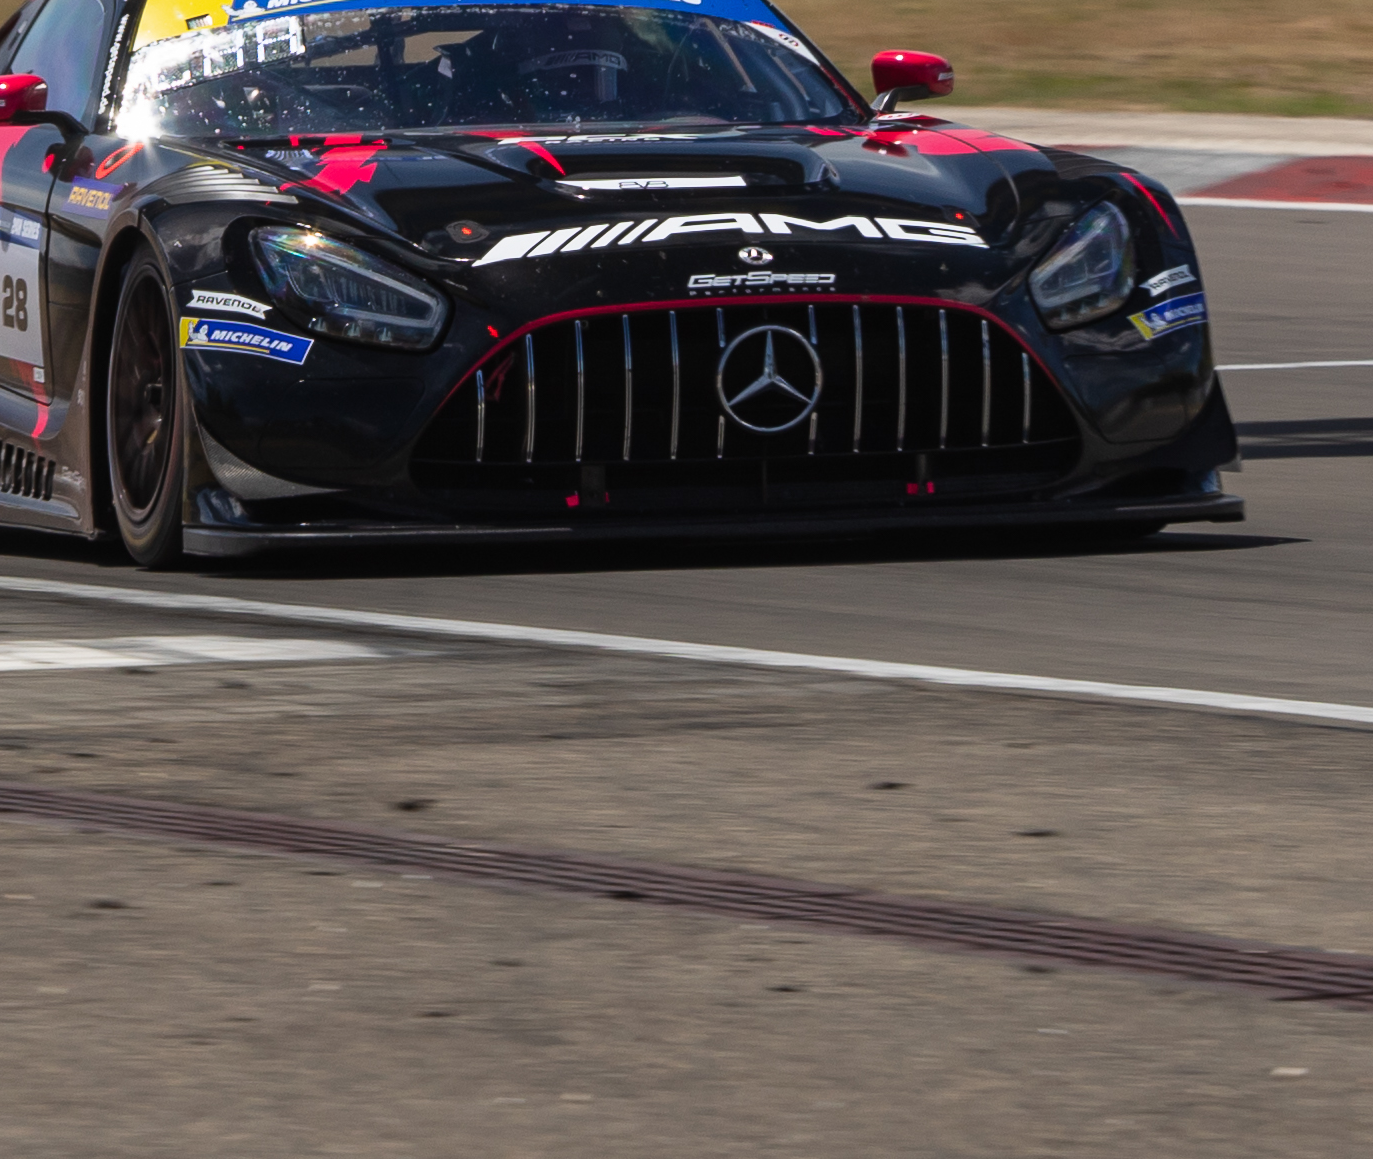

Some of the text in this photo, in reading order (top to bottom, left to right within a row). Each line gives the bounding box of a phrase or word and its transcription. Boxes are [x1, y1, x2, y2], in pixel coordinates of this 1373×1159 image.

[68, 186, 112, 210] RAVENOL
[642, 213, 991, 248] AMG
[2, 274, 29, 332] 28
[210, 329, 294, 352] MICHELIN
